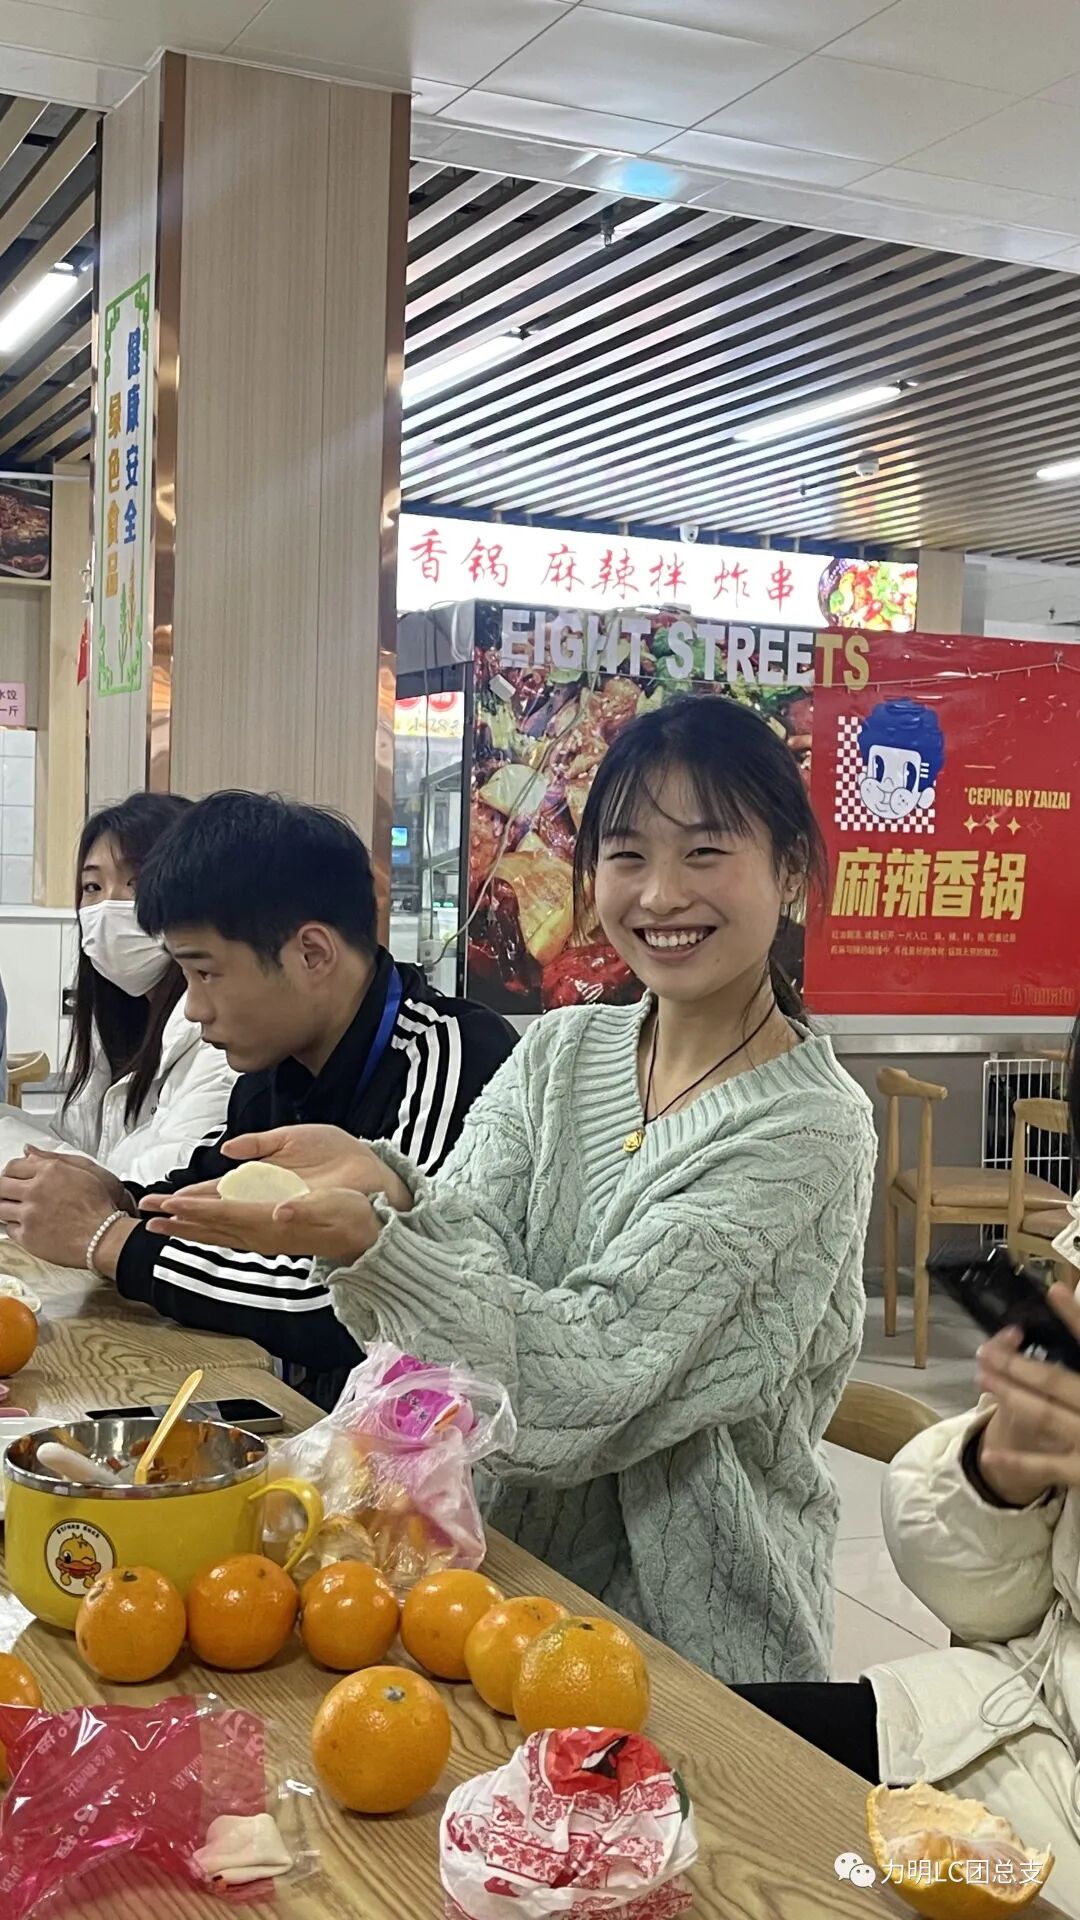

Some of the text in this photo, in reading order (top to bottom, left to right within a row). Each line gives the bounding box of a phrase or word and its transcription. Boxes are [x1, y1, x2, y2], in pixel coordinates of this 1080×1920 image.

[123, 326, 141, 544] 健康安全
[106, 391, 121, 598] 绿色食品
[410, 529, 508, 588] 香锅
[541, 543, 687, 600] 麻辣拌
[713, 559, 795, 614] 炸串
[502, 608, 870, 691] EIGHT STREETS
[1015, 789, 1032, 808] BY
[1033, 790, 1071, 810] ZAIZAI
[831, 846, 1027, 921] 麻辣香锅
